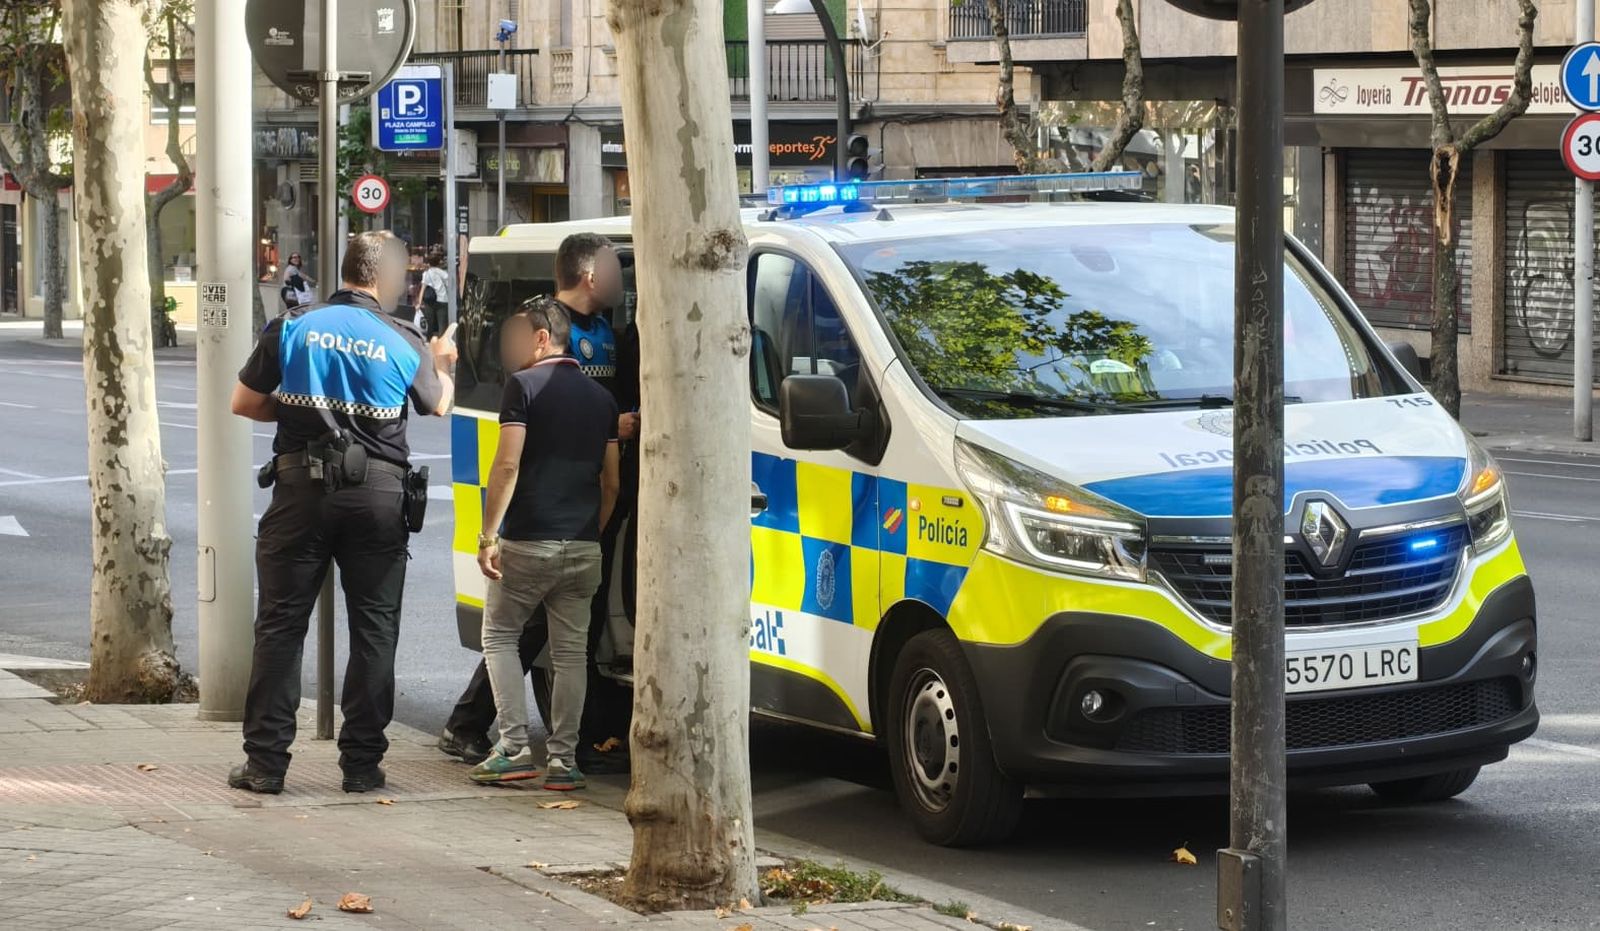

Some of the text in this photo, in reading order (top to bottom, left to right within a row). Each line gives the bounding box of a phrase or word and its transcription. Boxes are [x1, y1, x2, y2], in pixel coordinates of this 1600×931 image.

[398, 85, 421, 115] P
[1356, 84, 1391, 106] Joyería
[385, 121, 405, 129] PLAZA
[768, 142, 815, 156] eportes
[361, 187, 382, 200] 30
[1386, 397, 1433, 409] 715
[919, 515, 967, 547] Policía
[1285, 648, 1411, 685] 5570 LRC
